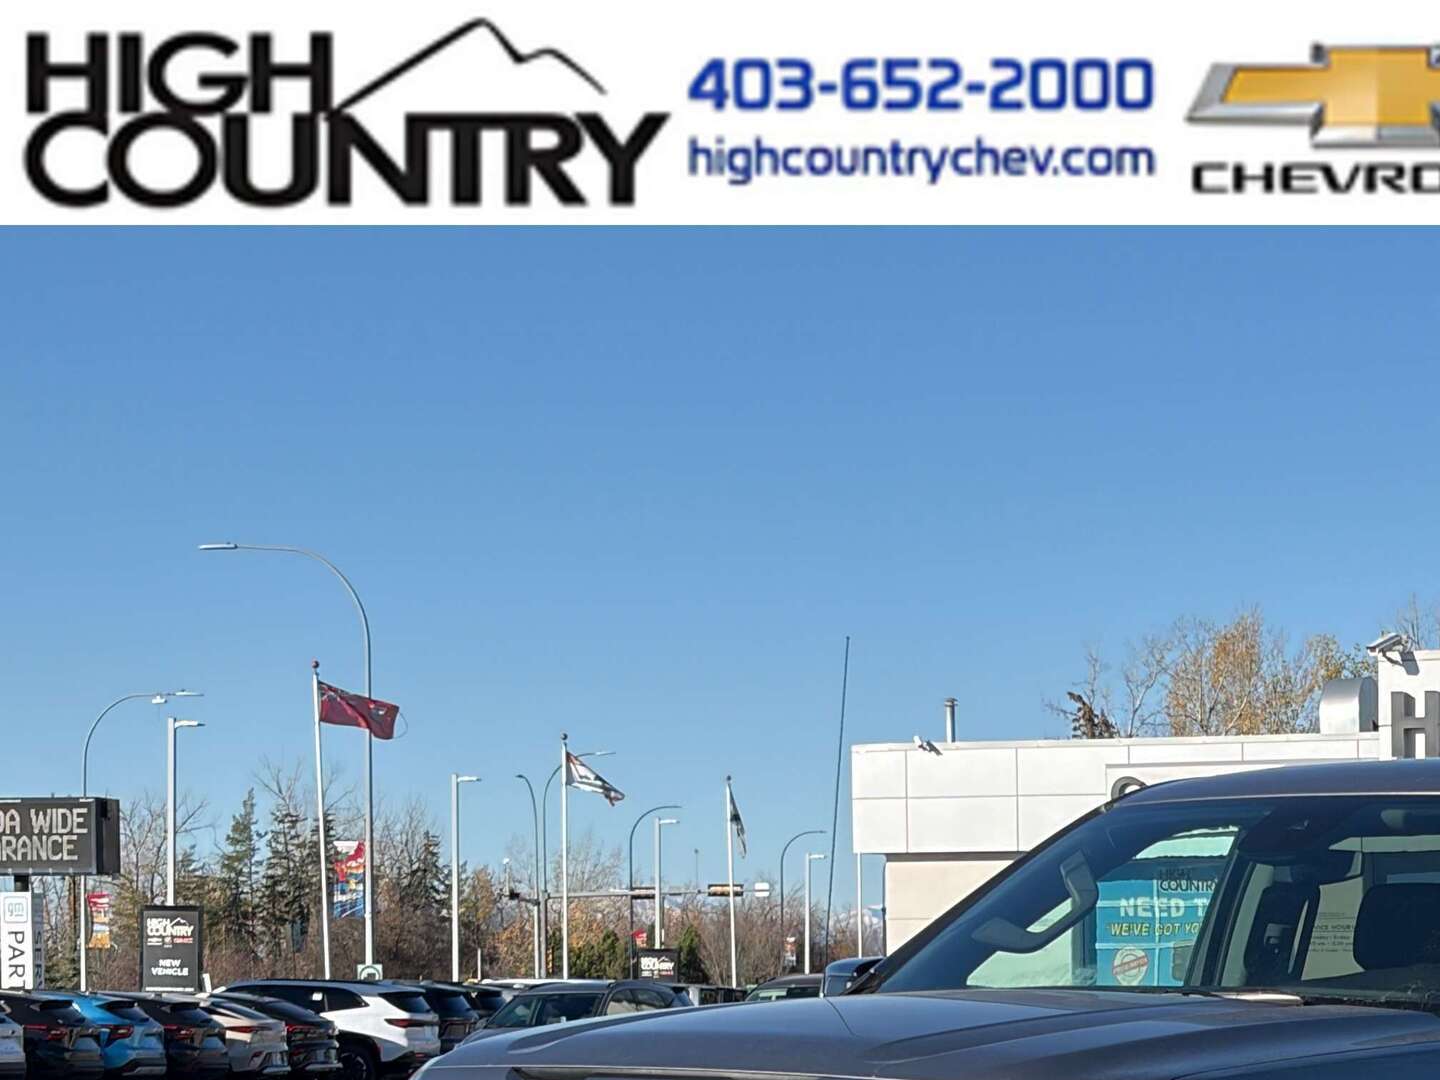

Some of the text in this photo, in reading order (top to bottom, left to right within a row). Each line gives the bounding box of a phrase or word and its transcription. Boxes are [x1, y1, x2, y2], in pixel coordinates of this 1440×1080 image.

[30, 808, 88, 834] WIDE
[0, 835, 78, 861] RANCE
[1160, 878, 1218, 892] COUNTR
[1120, 897, 1185, 917] NEED
[1111, 923, 1149, 936] WE'VE
[1155, 923, 1179, 935] GOT
[158, 958, 181, 967] NEW
[150, 967, 189, 976] VEHICLE
